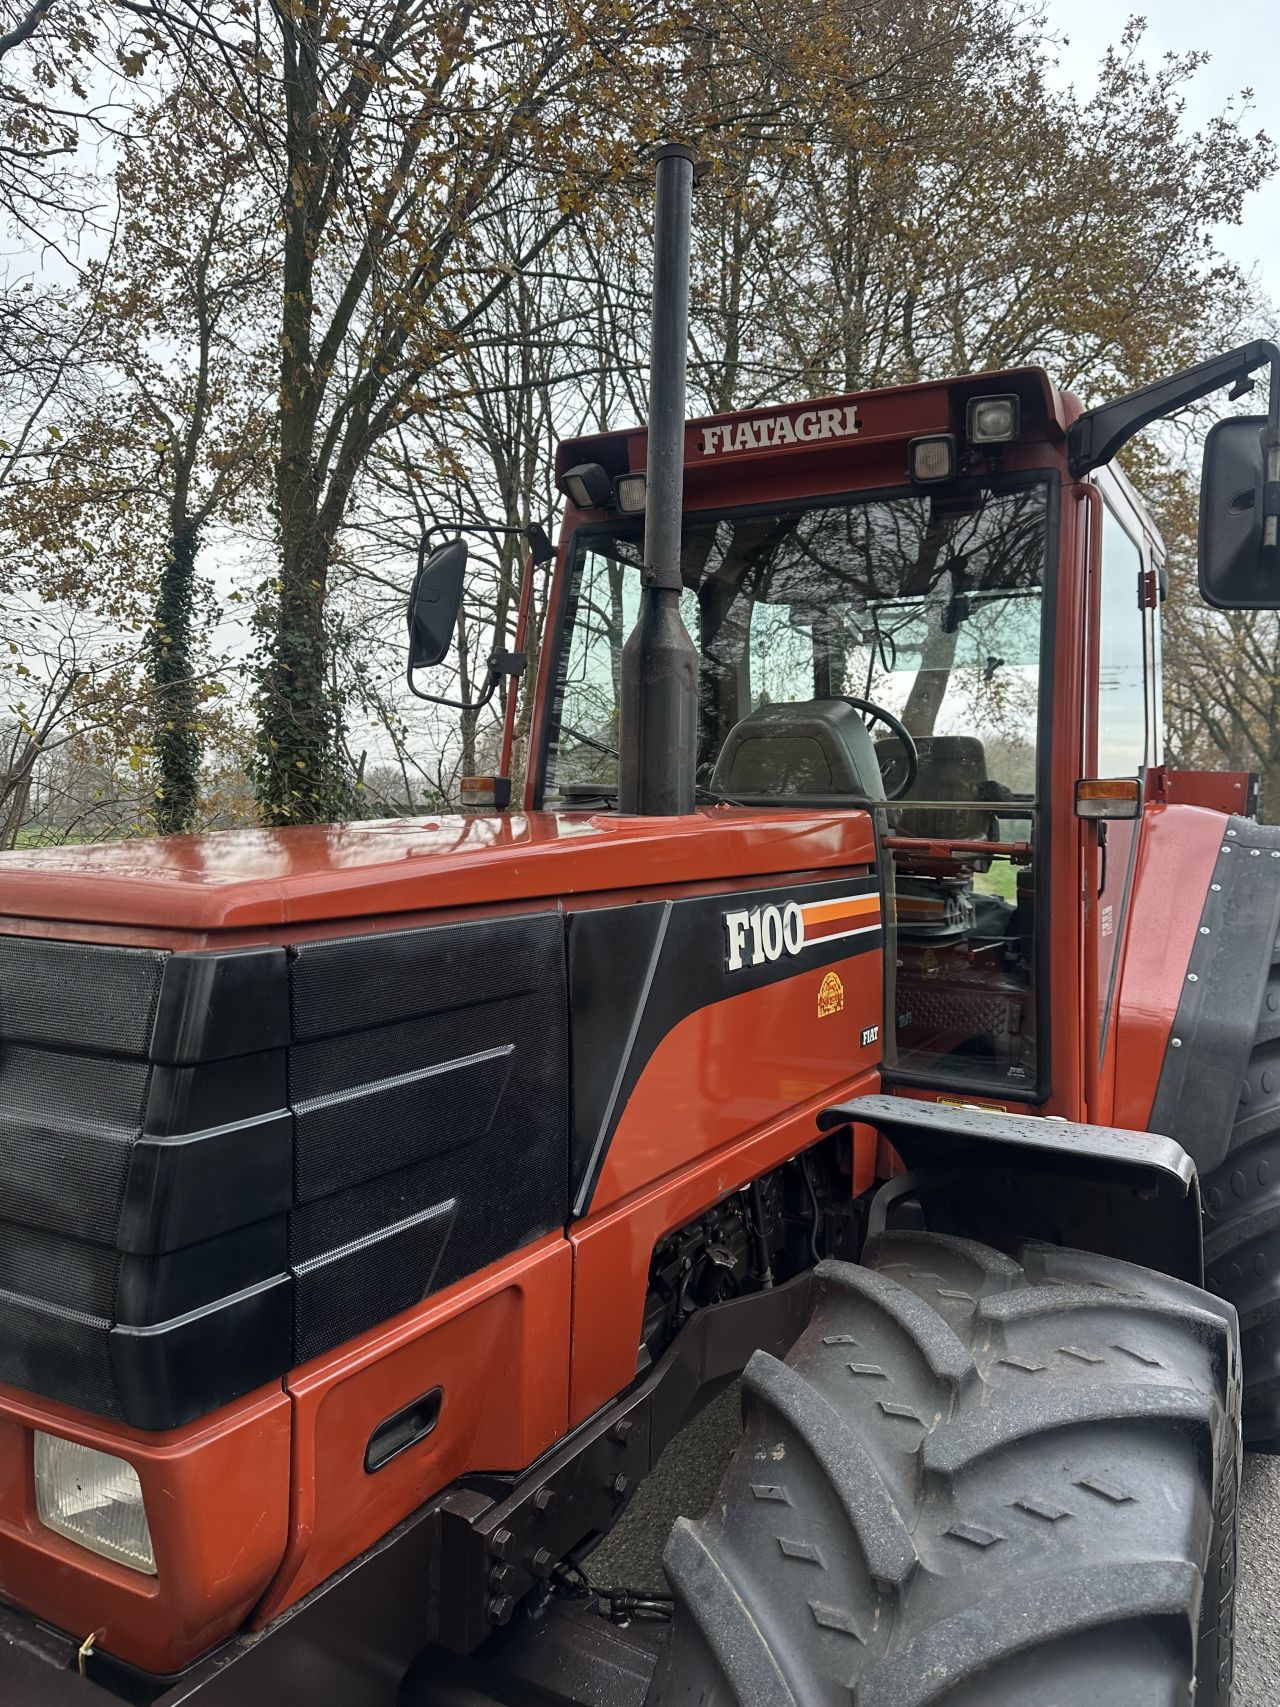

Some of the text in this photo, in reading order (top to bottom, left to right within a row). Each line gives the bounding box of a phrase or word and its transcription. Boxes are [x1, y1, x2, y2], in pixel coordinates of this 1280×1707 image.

[702, 406, 859, 455] FIATAGRI
[726, 902, 804, 971] F100
[862, 1027, 879, 1046] FIAT
